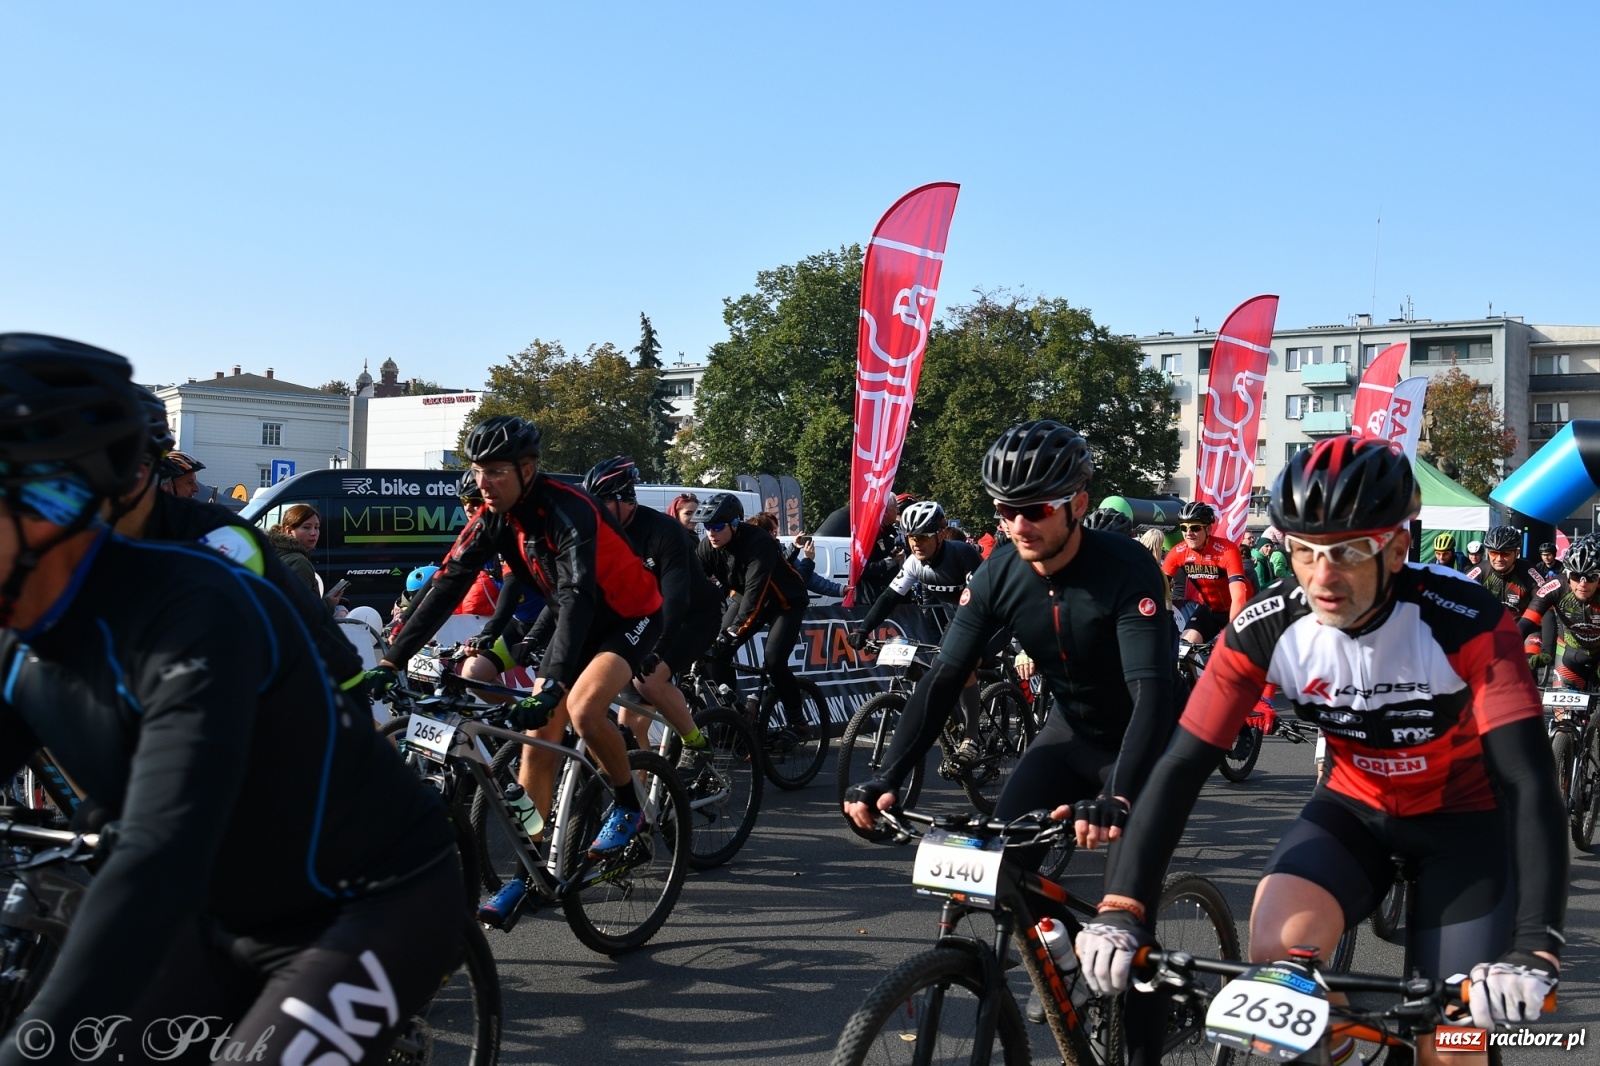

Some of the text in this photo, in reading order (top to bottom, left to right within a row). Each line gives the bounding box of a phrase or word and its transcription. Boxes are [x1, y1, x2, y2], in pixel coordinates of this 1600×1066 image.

[380, 478, 421, 496] bike
[346, 568, 391, 576] MERIDA
[1237, 598, 1281, 627] ORLEN
[1422, 589, 1480, 619] KROSS
[1551, 693, 1582, 704] 1235
[413, 721, 445, 745] 2656
[1391, 726, 1435, 744] FOX
[1356, 757, 1422, 774] ORLEN
[930, 858, 984, 884] 3140
[1222, 993, 1317, 1037] 2638
